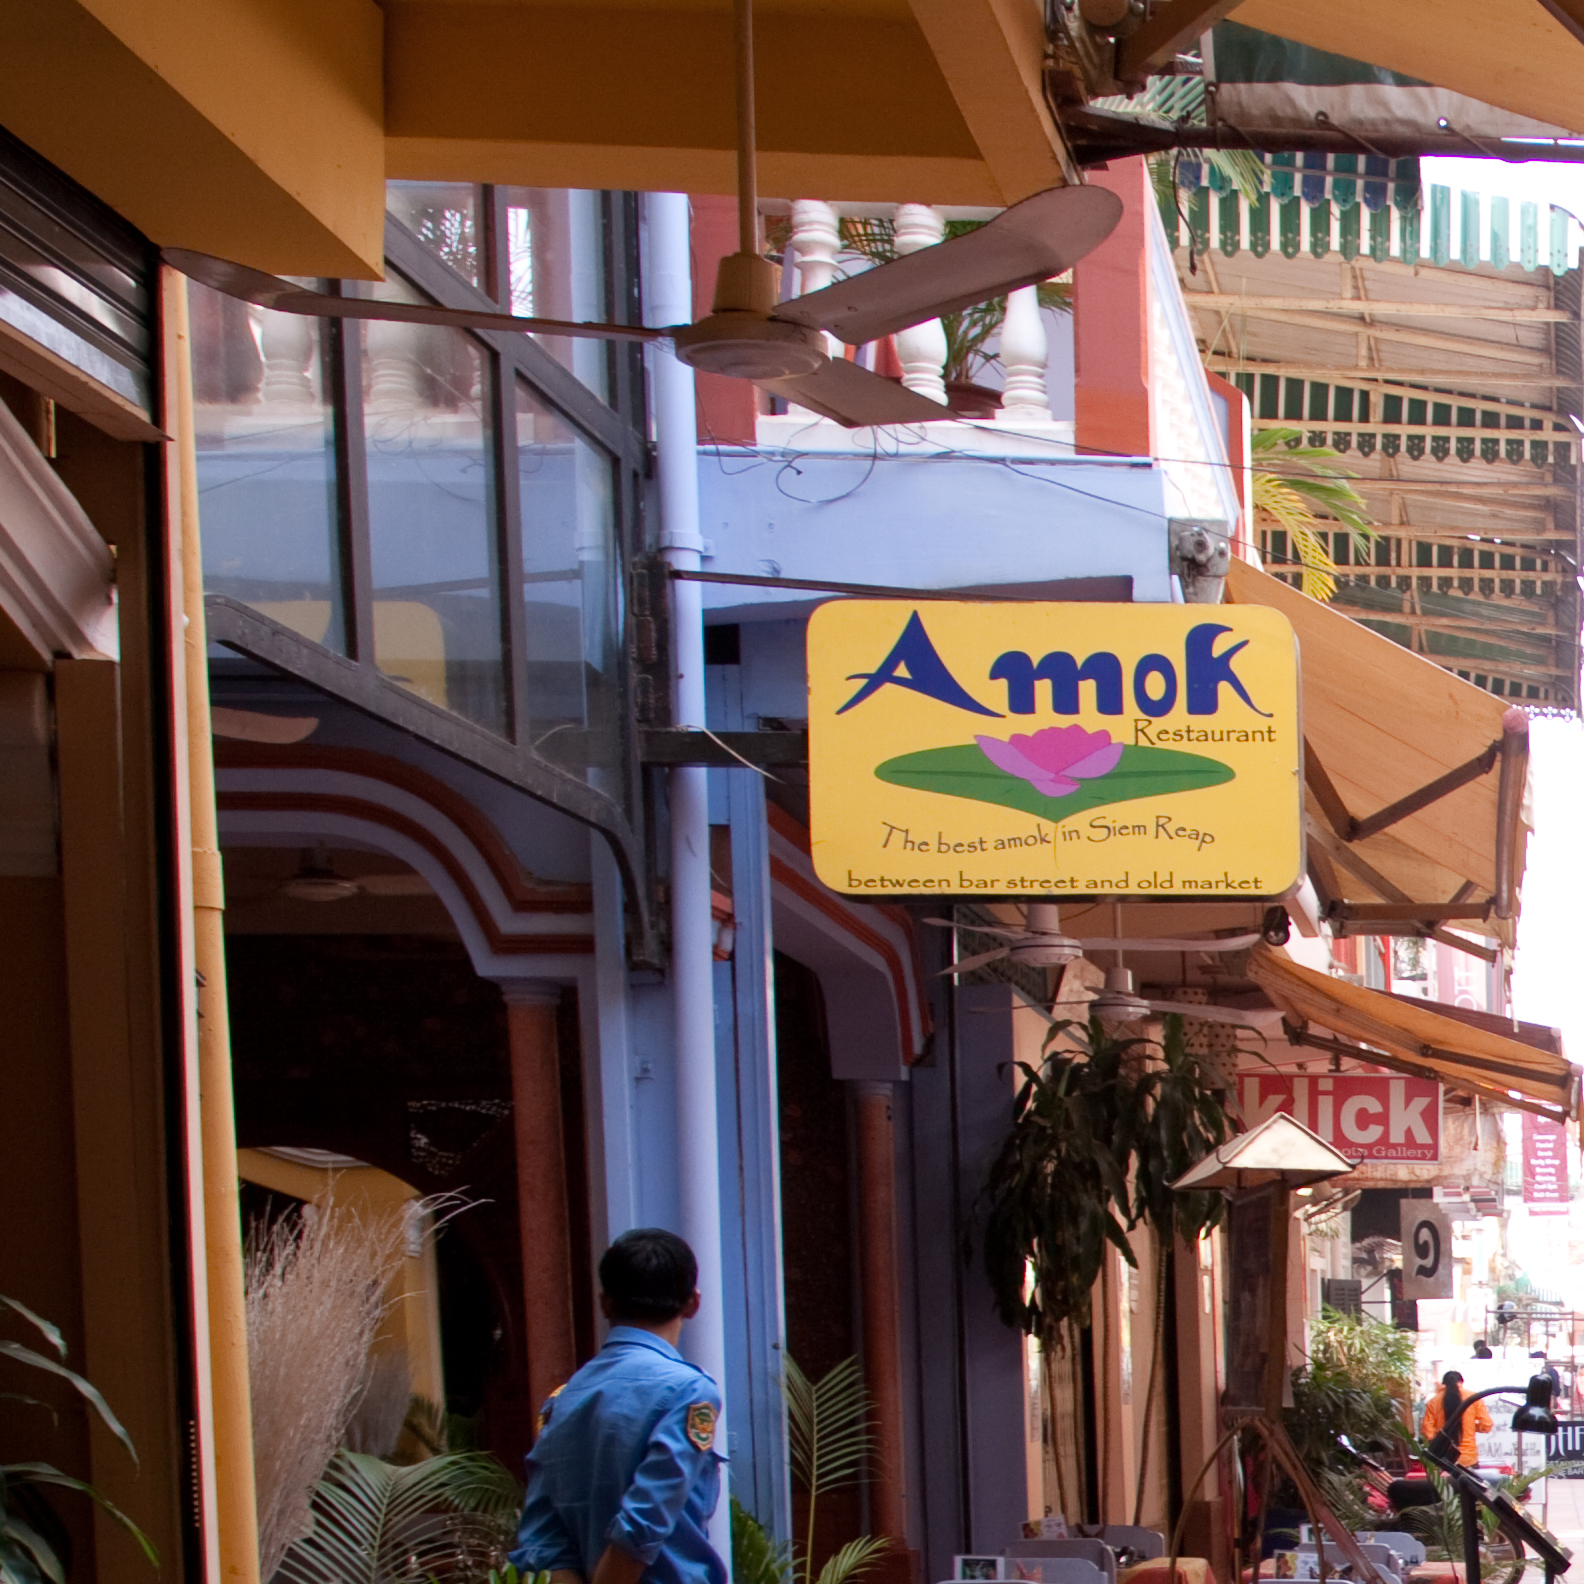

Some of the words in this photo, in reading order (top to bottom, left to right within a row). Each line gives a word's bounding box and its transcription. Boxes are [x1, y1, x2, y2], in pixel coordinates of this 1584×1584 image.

[835, 609, 1274, 718] Amok
[1133, 718, 1277, 747] Restaurant
[880, 821, 931, 853] The
[936, 831, 987, 855] best
[993, 823, 1051, 851] amok
[1061, 823, 1081, 843] in
[1086, 816, 1147, 843] Siem
[1154, 815, 1216, 852] Reap
[847, 869, 954, 891] between
[958, 870, 1001, 891] bar
[1006, 872, 1080, 891] street
[1084, 871, 1130, 891] and
[1136, 870, 1175, 891] old
[1181, 871, 1263, 891] market
[1372, 1145, 1434, 1160] Gallery
